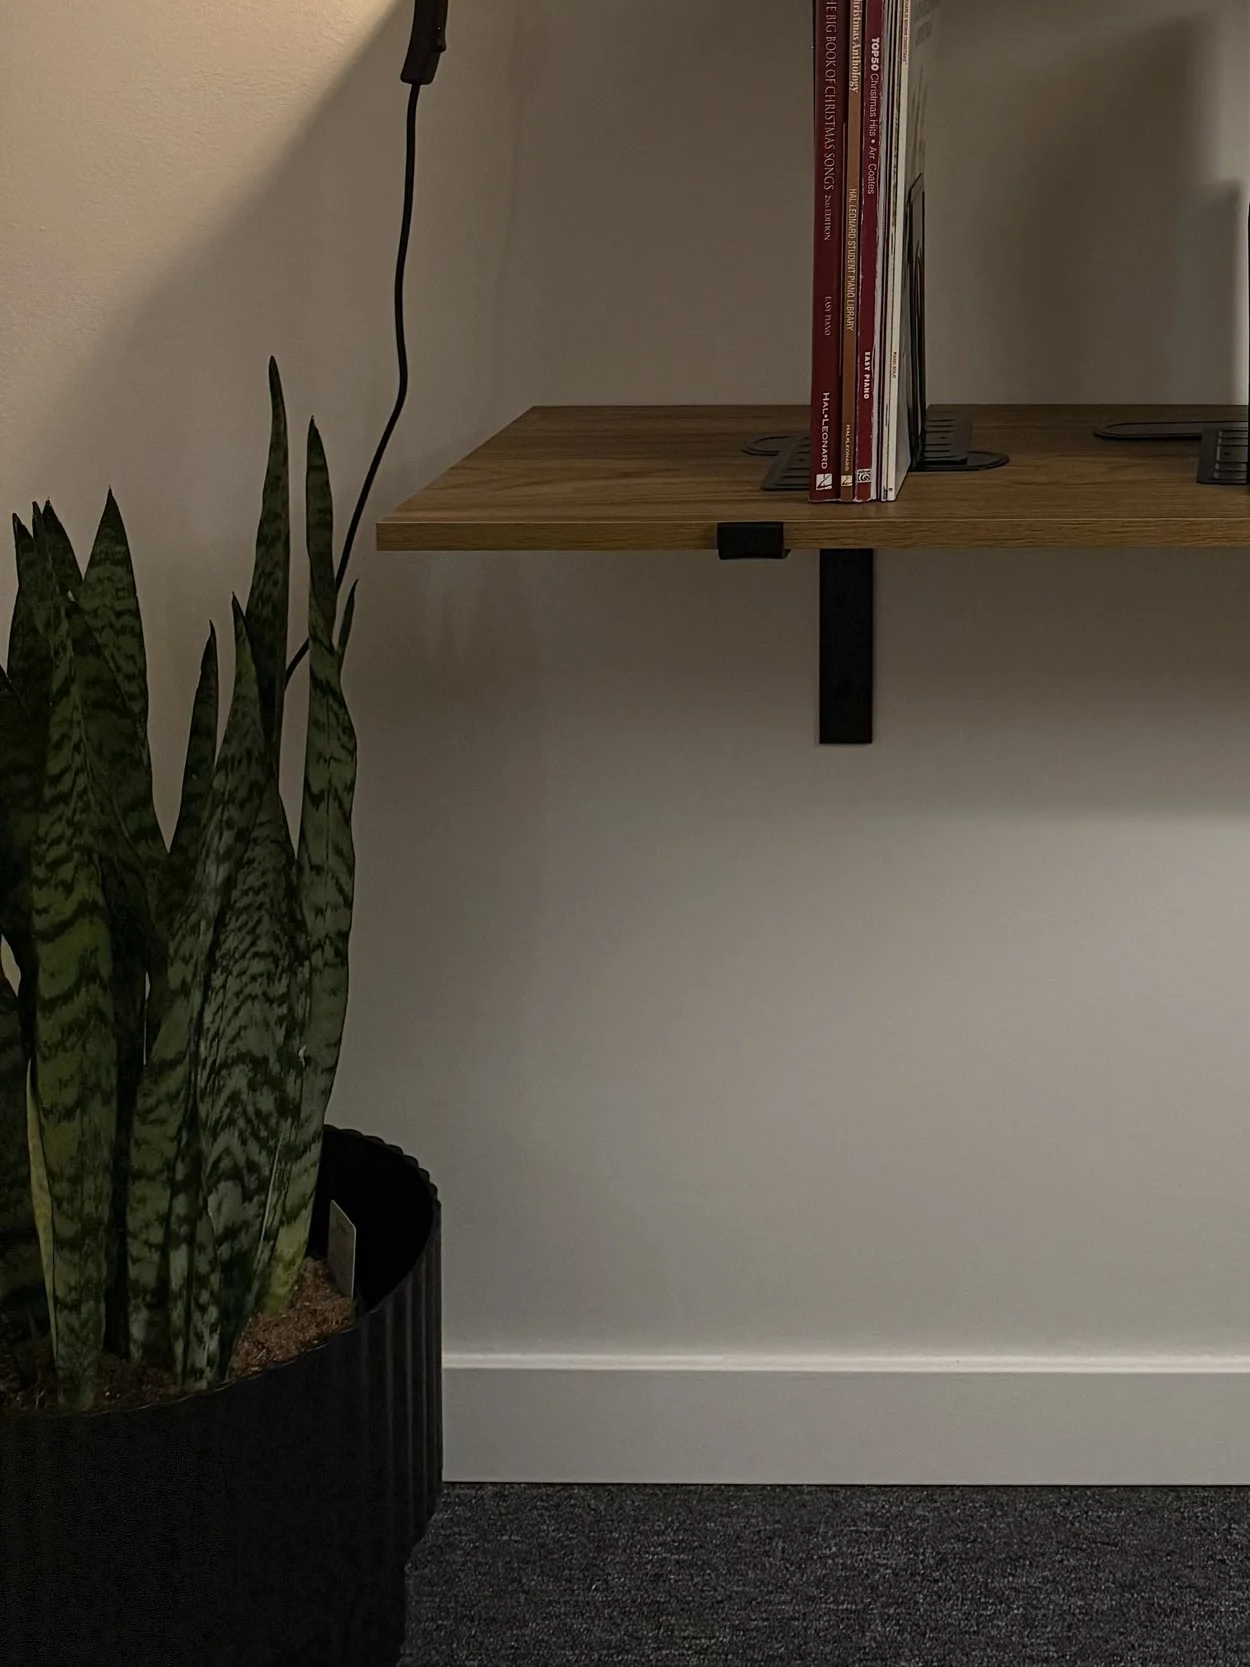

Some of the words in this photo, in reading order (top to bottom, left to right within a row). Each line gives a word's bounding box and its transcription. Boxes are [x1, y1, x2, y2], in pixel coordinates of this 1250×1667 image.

[826, 14, 837, 33] BIG
[825, 36, 837, 67] BOOK
[850, 42, 861, 93] Anthology
[825, 69, 837, 84] OF
[869, 72, 879, 118] Christmas
[824, 86, 836, 150] CHRISTMAS
[869, 119, 877, 137] Hits
[824, 152, 836, 191] SONGS
[867, 163, 876, 195] Coates
[848, 188, 857, 203] HAL
[847, 204, 857, 239] LEONARD
[846, 240, 856, 275] STUDENT
[846, 275, 855, 299] PIANO
[845, 299, 855, 331] LIBRARY
